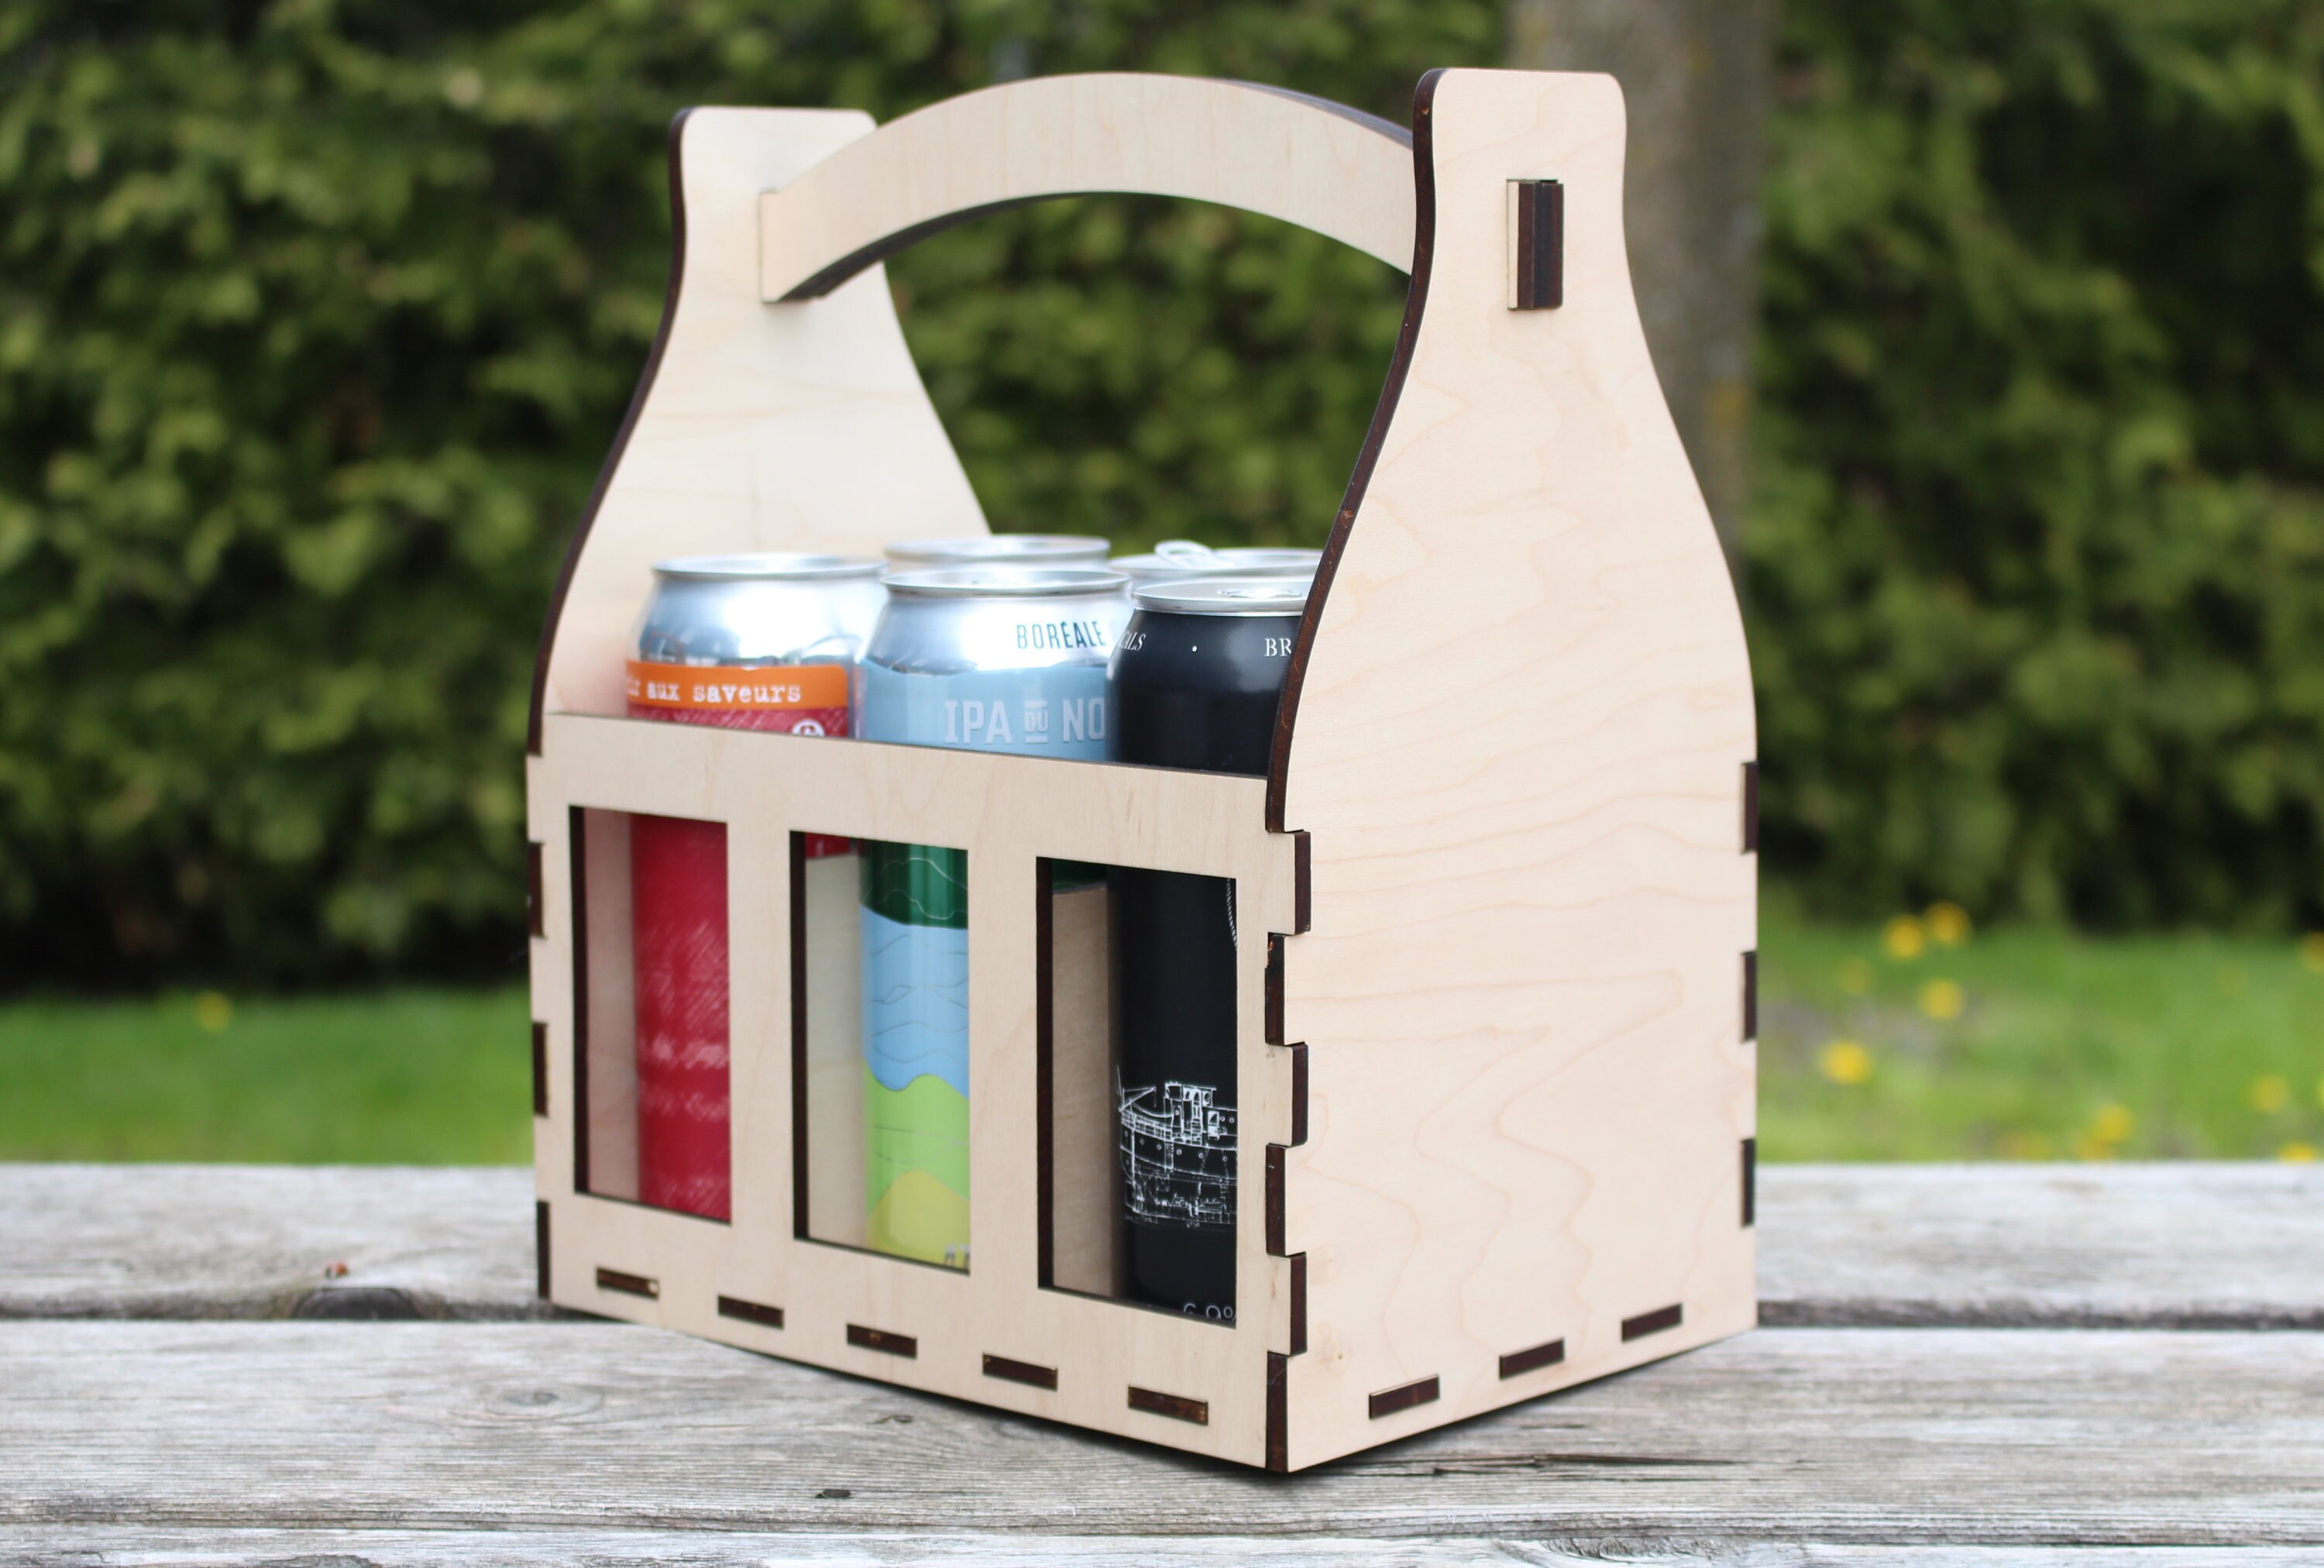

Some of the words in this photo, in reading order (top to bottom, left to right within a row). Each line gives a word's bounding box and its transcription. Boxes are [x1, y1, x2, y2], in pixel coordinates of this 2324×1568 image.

[1263, 638, 1292, 658] BR
[646, 681, 681, 701] aux
[693, 683, 801, 703] saveurs
[945, 700, 1012, 744] IPA
[1024, 710, 1048, 732] DU
[1063, 697, 1105, 744] NO
